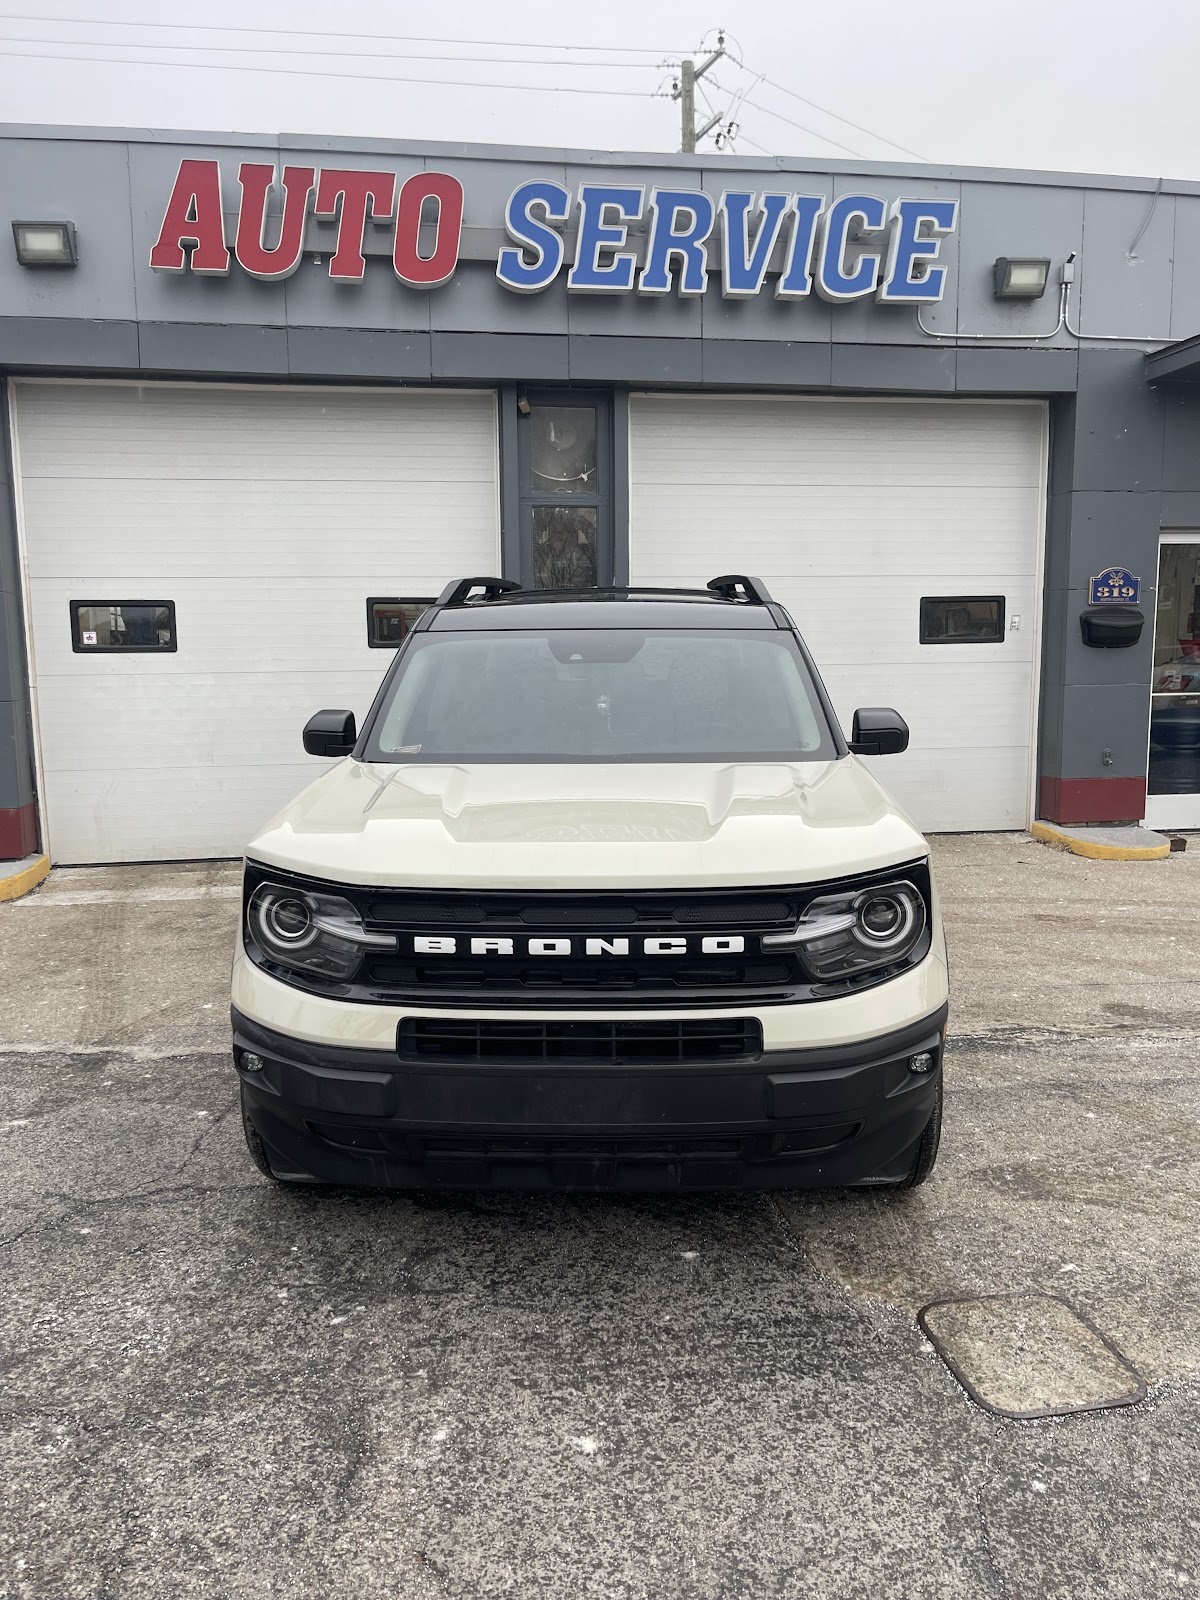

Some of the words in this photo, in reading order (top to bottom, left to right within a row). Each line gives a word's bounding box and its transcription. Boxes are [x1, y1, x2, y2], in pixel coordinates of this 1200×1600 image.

[149, 159, 465, 288] AUTO
[496, 178, 960, 304] SERVICE
[1096, 586, 1135, 597] 319
[413, 935, 745, 956] BRONCO
